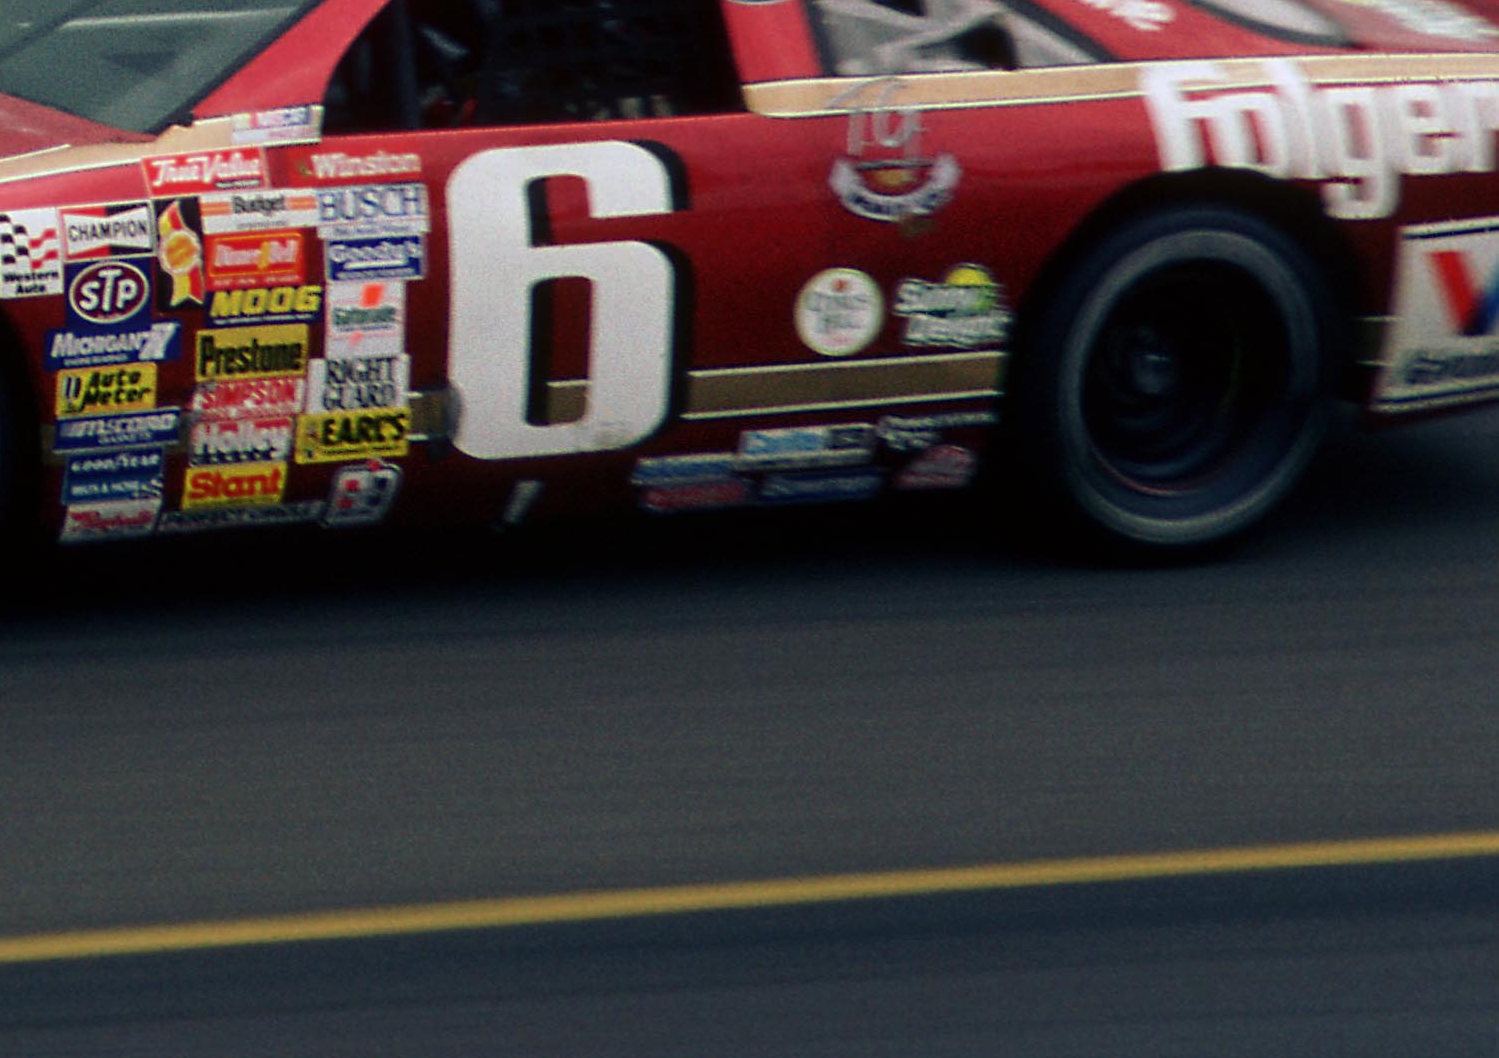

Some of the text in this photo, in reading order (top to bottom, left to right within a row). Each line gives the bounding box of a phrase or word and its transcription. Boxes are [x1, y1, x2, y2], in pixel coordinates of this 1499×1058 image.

[310, 149, 422, 180] Winston
[231, 195, 286, 217] Budget
[317, 184, 421, 223] BUSCH
[67, 218, 148, 243] CHAMPION
[3, 270, 59, 284] Western
[15, 281, 46, 295] Auto
[77, 268, 139, 313] STP
[209, 284, 322, 318] MOOG
[445, 140, 682, 460] 6
[200, 333, 303, 377] Prestone
[89, 370, 141, 389] Auto
[324, 357, 395, 384] RIGHT
[81, 386, 151, 411] Meter
[322, 382, 396, 410] GUARD
[189, 467, 284, 500] Stant
